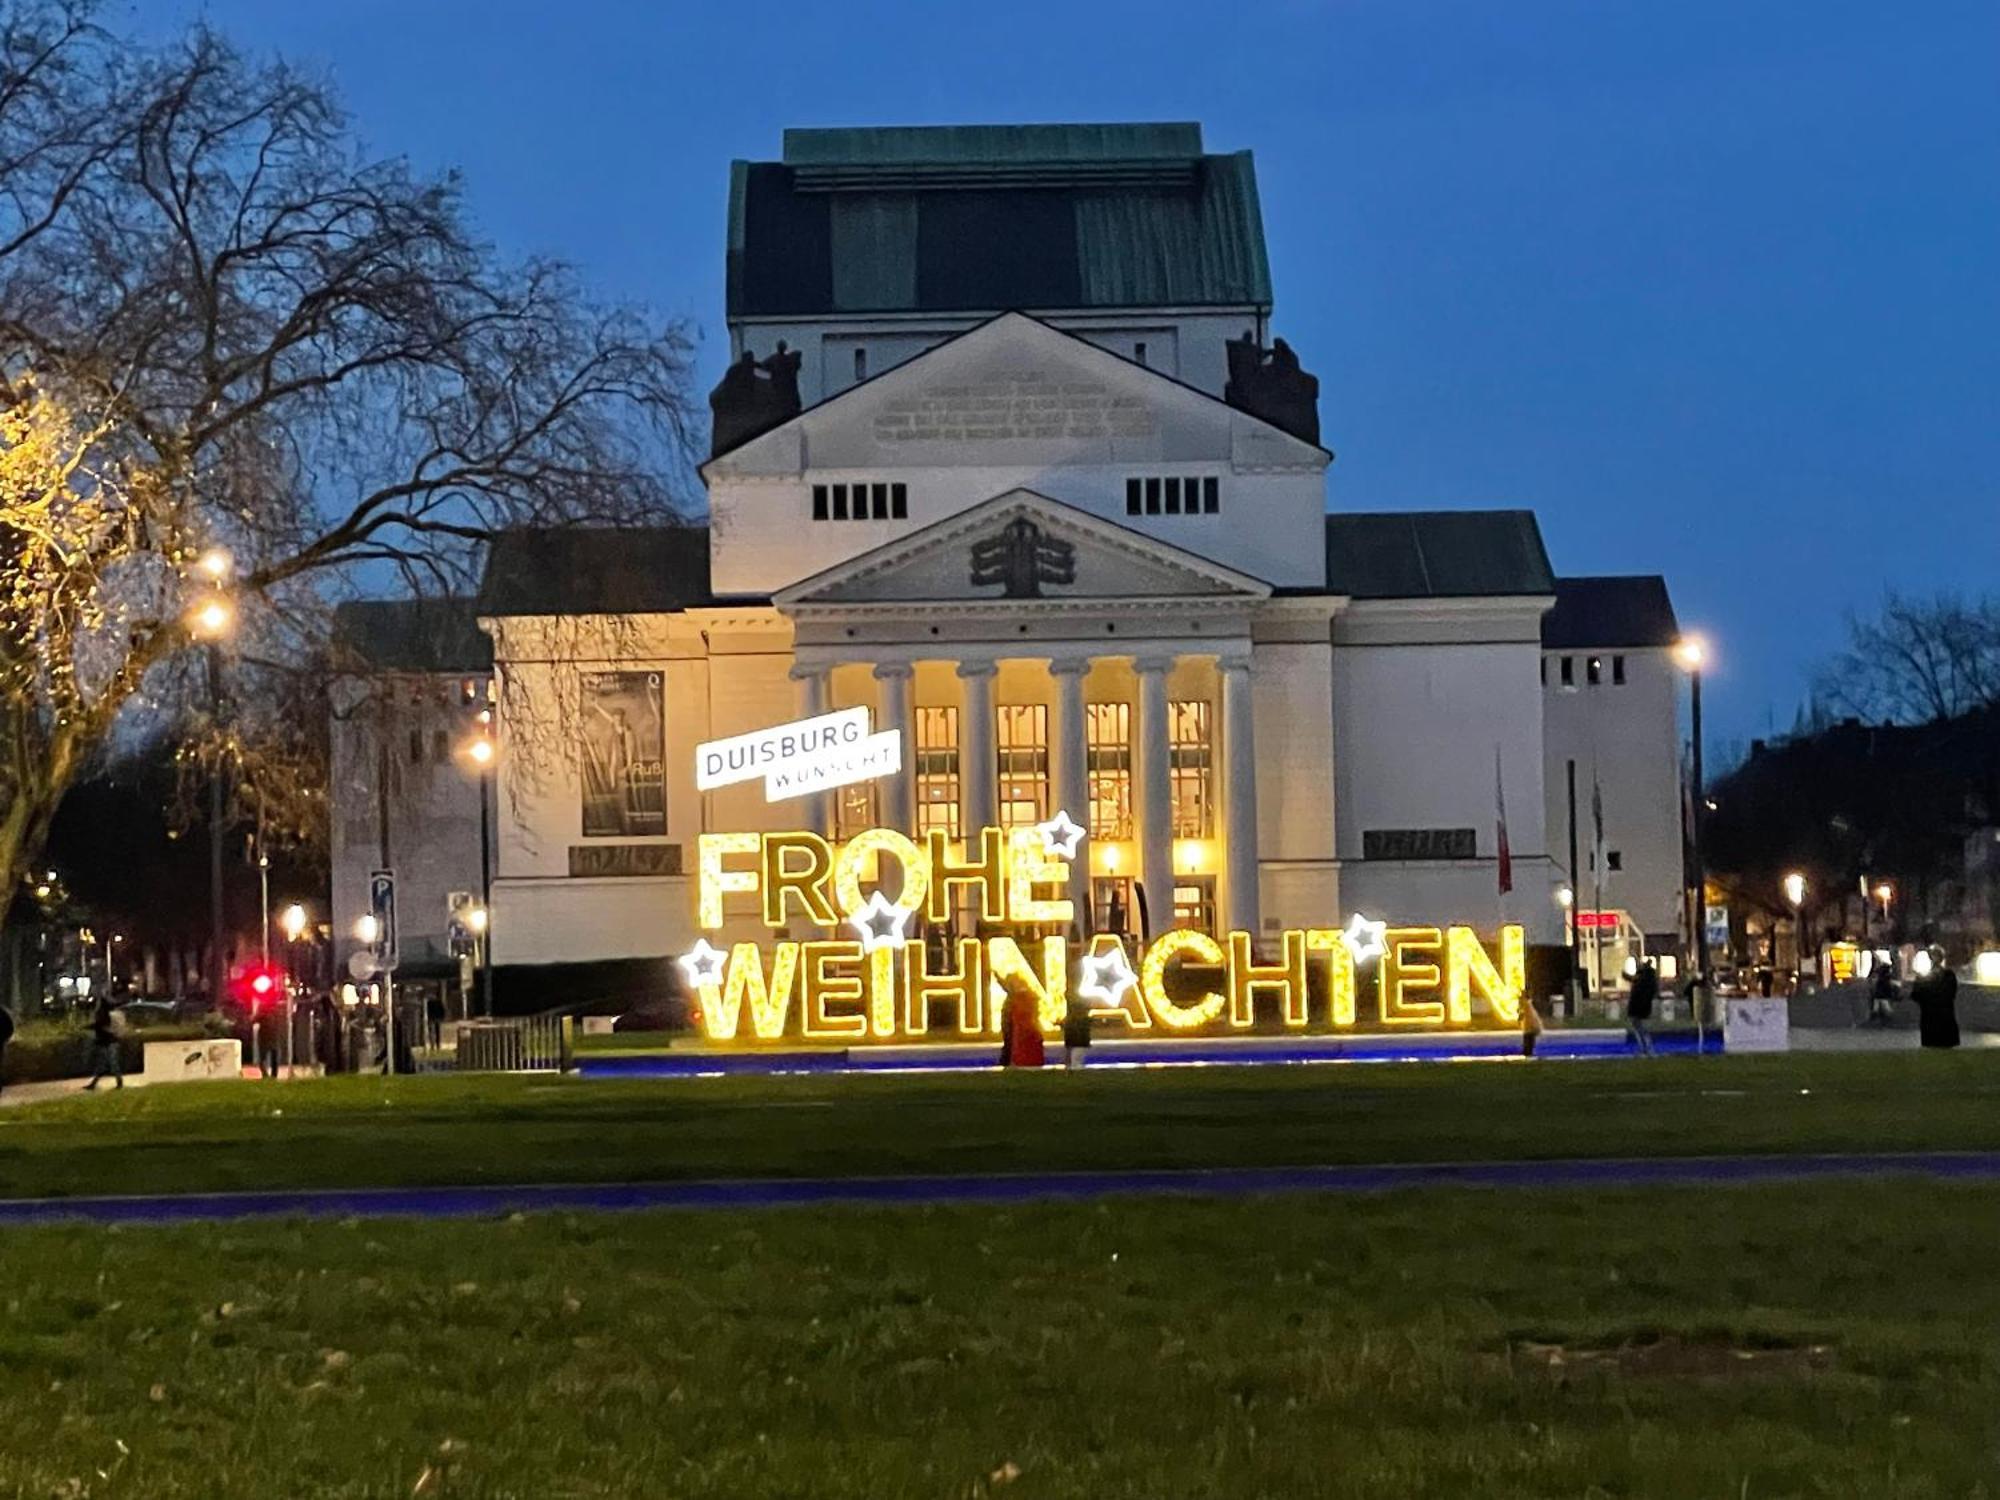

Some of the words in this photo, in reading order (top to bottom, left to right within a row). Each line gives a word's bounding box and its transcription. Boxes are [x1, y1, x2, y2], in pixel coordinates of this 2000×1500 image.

[706, 721, 859, 776] DUISBURG
[377, 880, 389, 896] P
[698, 826, 1076, 929] FROHE
[697, 924, 1526, 1040] WEIHNACHTEN
